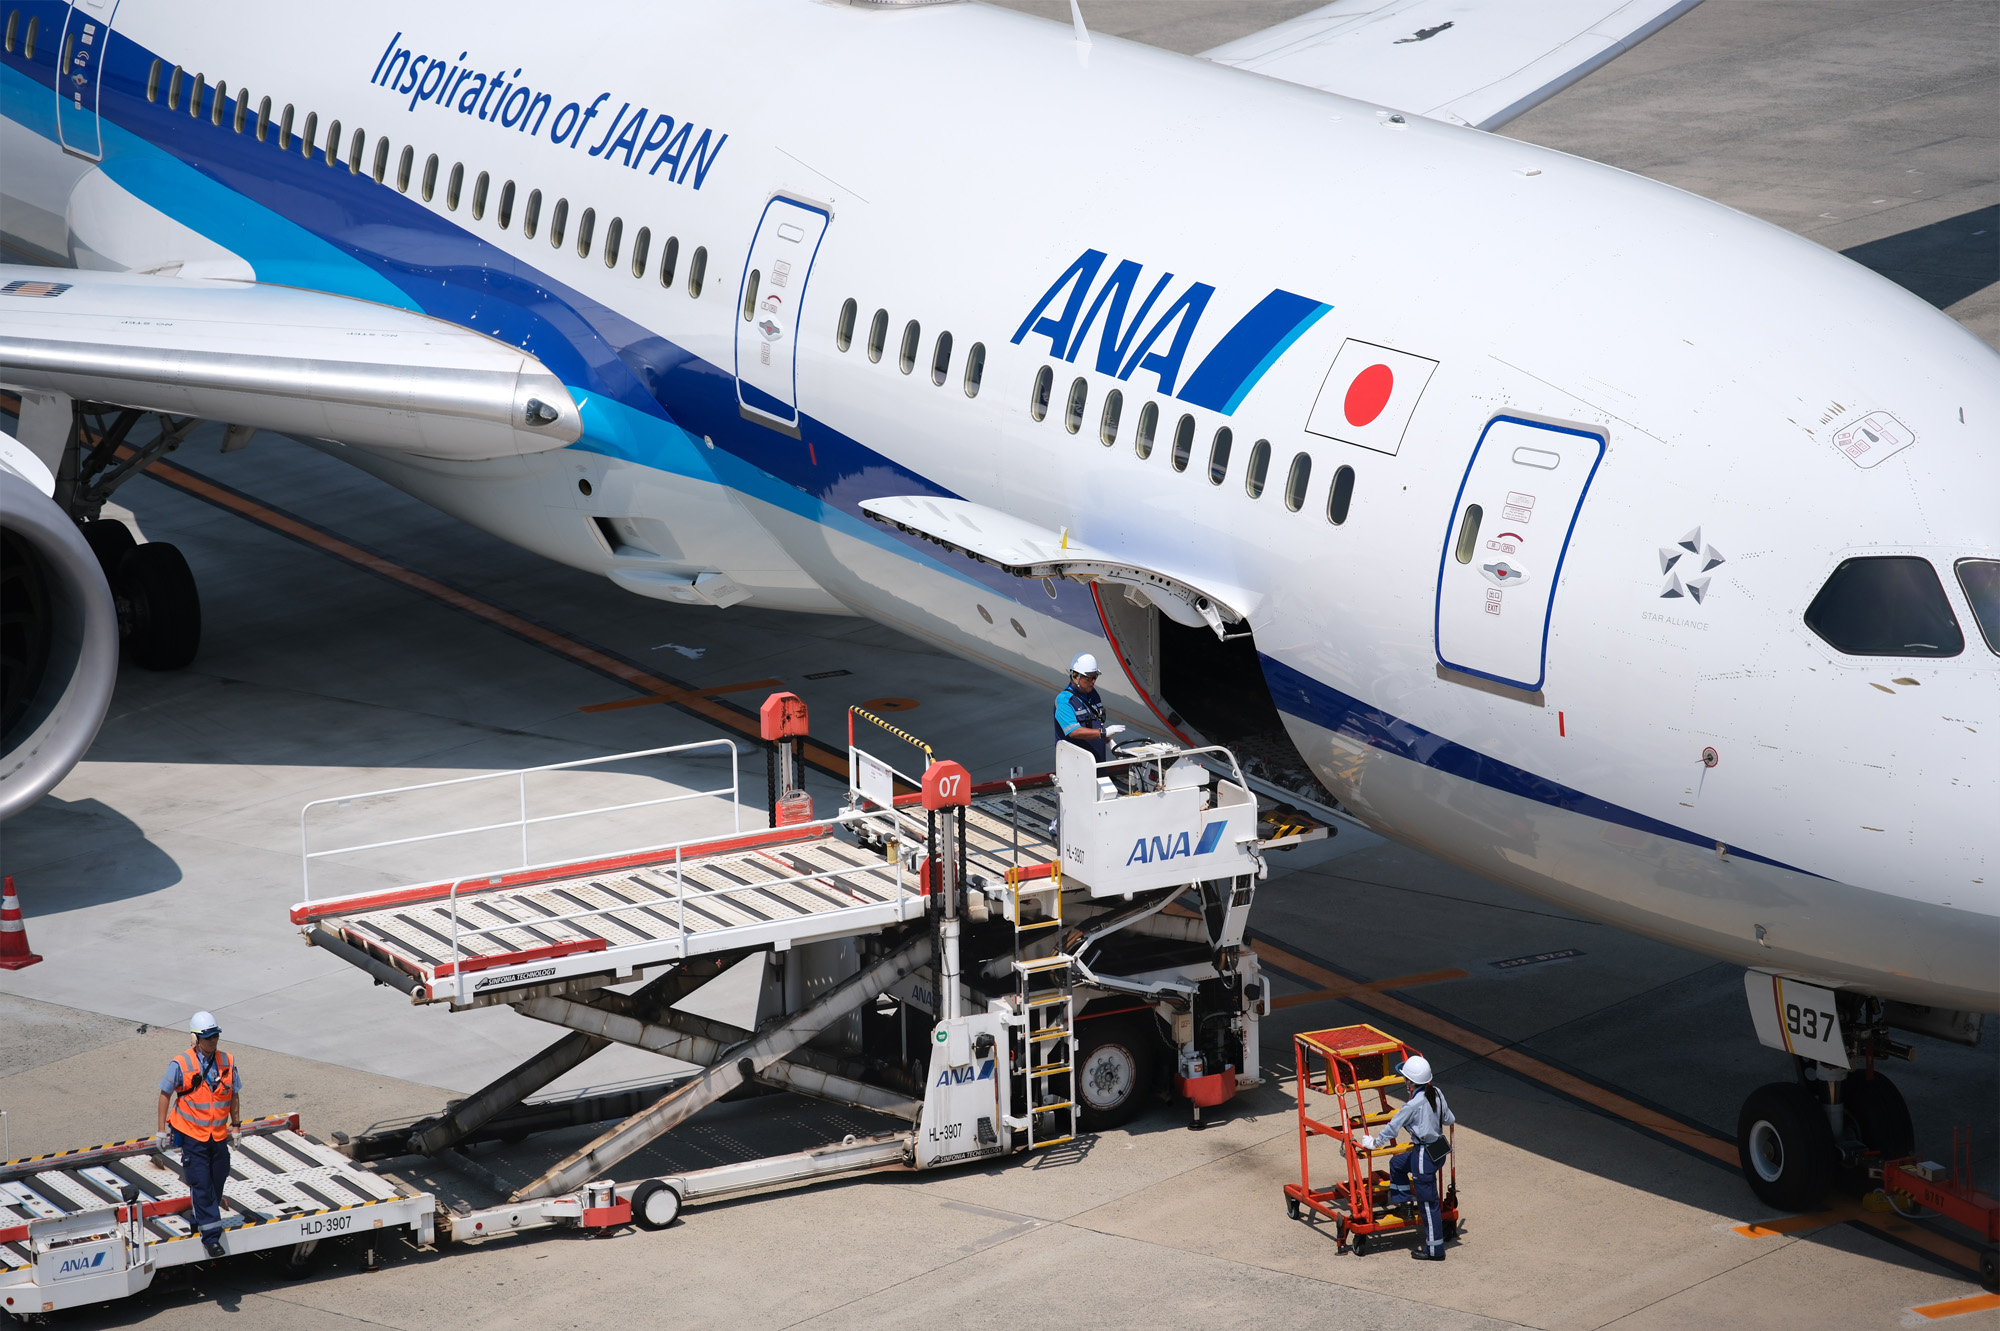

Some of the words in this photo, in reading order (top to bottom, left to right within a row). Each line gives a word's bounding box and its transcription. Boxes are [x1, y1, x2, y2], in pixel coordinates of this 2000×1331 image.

[371, 31, 552, 136] Inspiration
[550, 92, 611, 149] of
[588, 102, 729, 191] JAPAN
[1010, 248, 1216, 397] ANA
[1487, 603, 1499, 613] EXIT
[1641, 611, 1664, 622] STAR
[1665, 616, 1710, 631] ALLIANCE
[939, 774, 961, 798] 07
[1066, 843, 1085, 865] HL-3907
[1126, 831, 1191, 866] ANA
[488, 975, 516, 986] SINFONIA
[517, 968, 556, 980] TECHNOLOGY
[911, 984, 932, 1008] ANA
[1786, 1003, 1835, 1042] 937
[936, 1066, 976, 1087] ANA
[928, 1123, 962, 1142] HL-3907
[940, 1153, 966, 1164] SINFONIA
[966, 1146, 1003, 1159] TECHNOLOGY
[301, 1216, 351, 1236] HLD-3907
[60, 1257, 89, 1273] ANA
